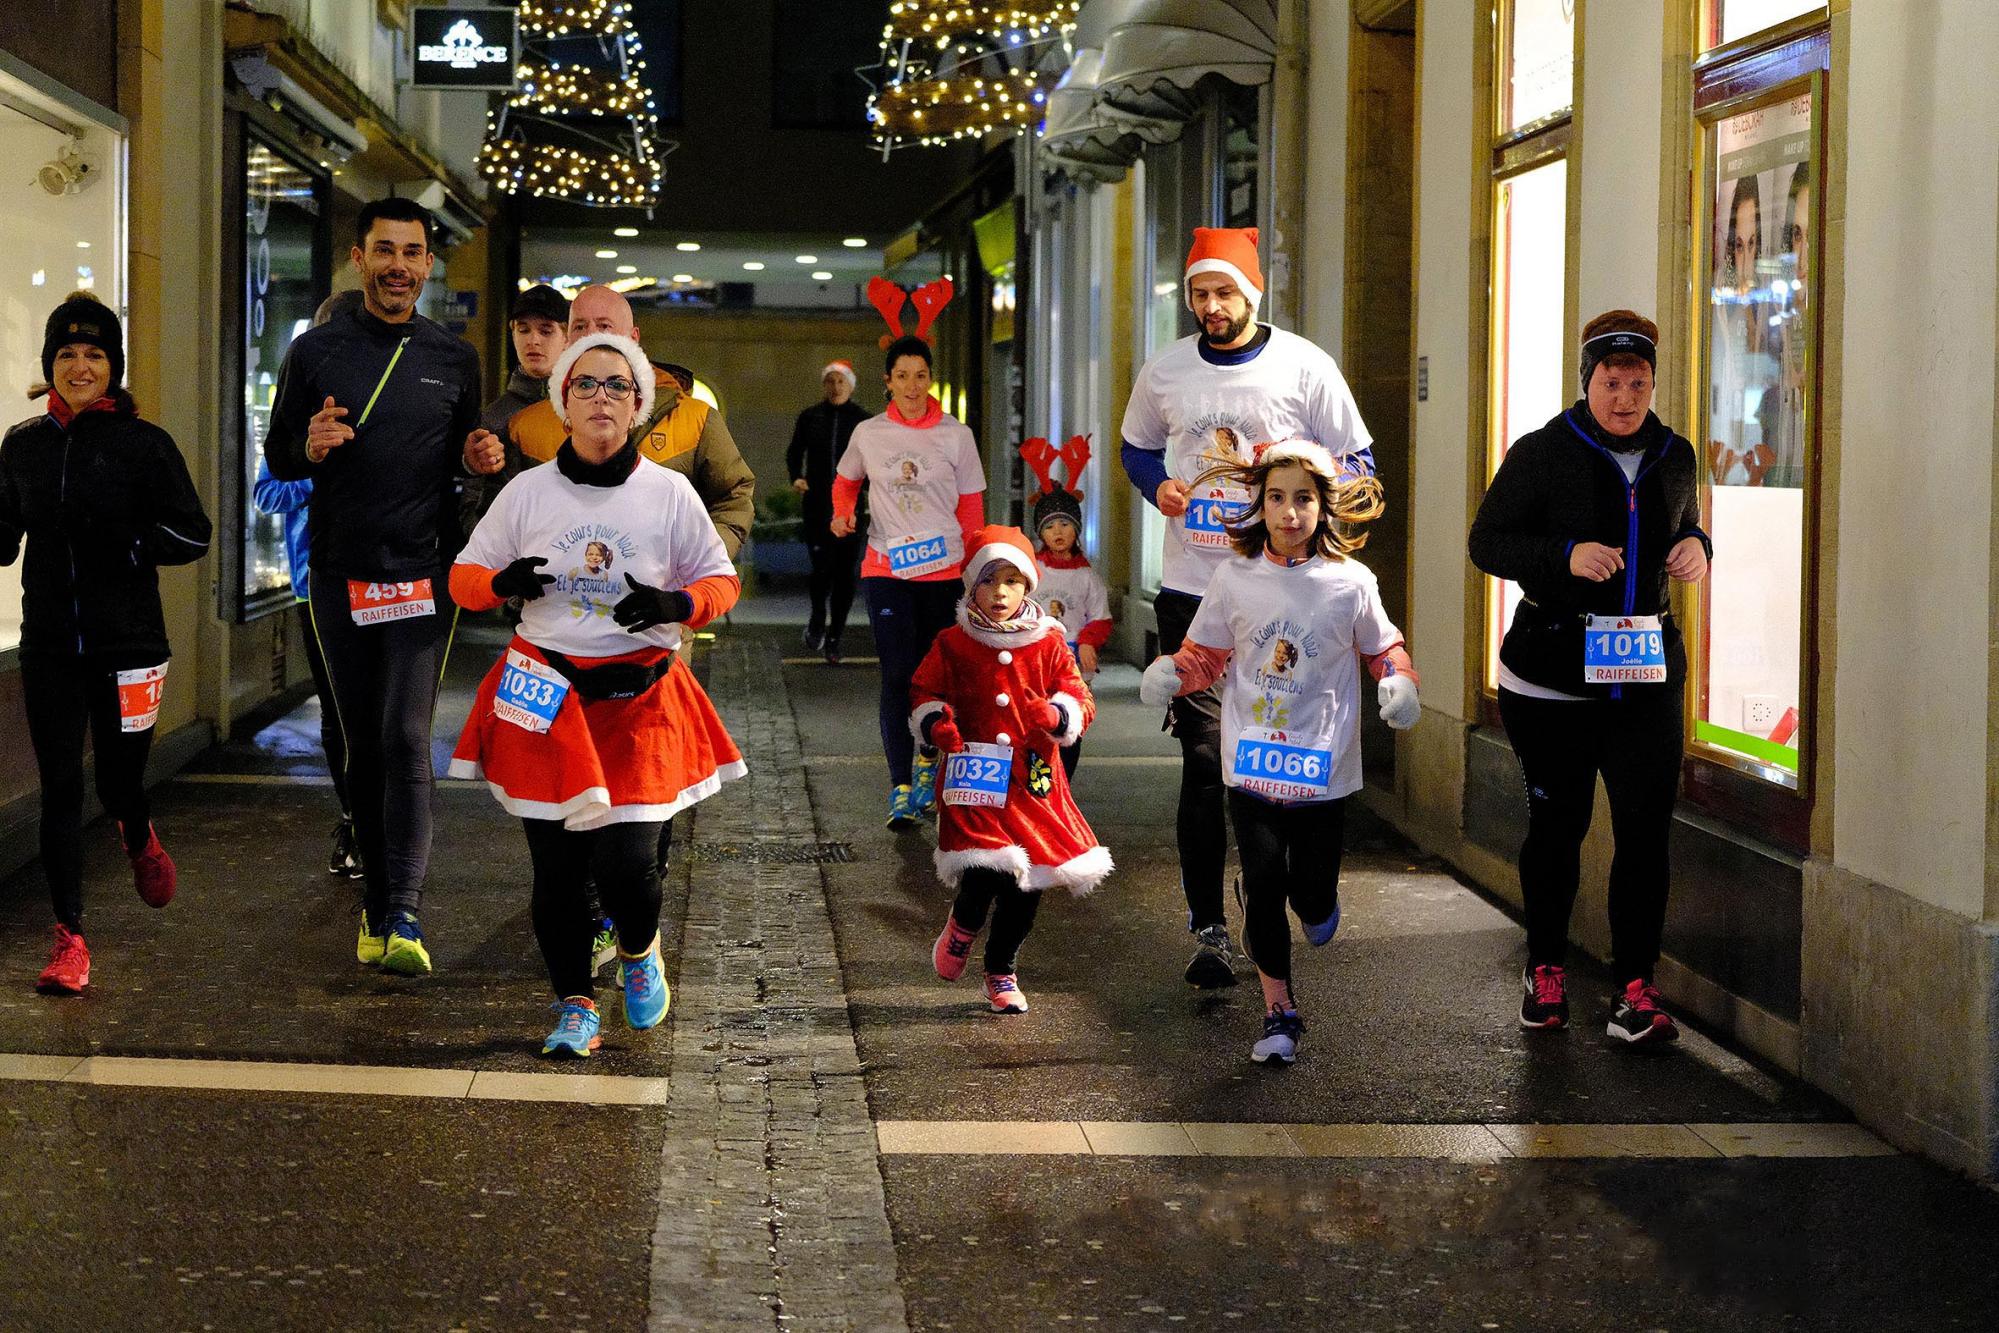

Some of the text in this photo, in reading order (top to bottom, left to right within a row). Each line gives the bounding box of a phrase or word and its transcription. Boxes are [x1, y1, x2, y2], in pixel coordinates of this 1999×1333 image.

[894, 541, 942, 565] 1064
[362, 602, 425, 623] RAIFFEISEN
[1596, 632, 1661, 656] 1019
[1596, 667, 1664, 680] RAIFFEISEN
[504, 668, 554, 706] 1033
[495, 701, 539, 729] RAIFFEISEN
[947, 757, 1001, 783] 1032
[1247, 747, 1321, 779] 1066
[1244, 778, 1316, 798] RAIFFEISEN
